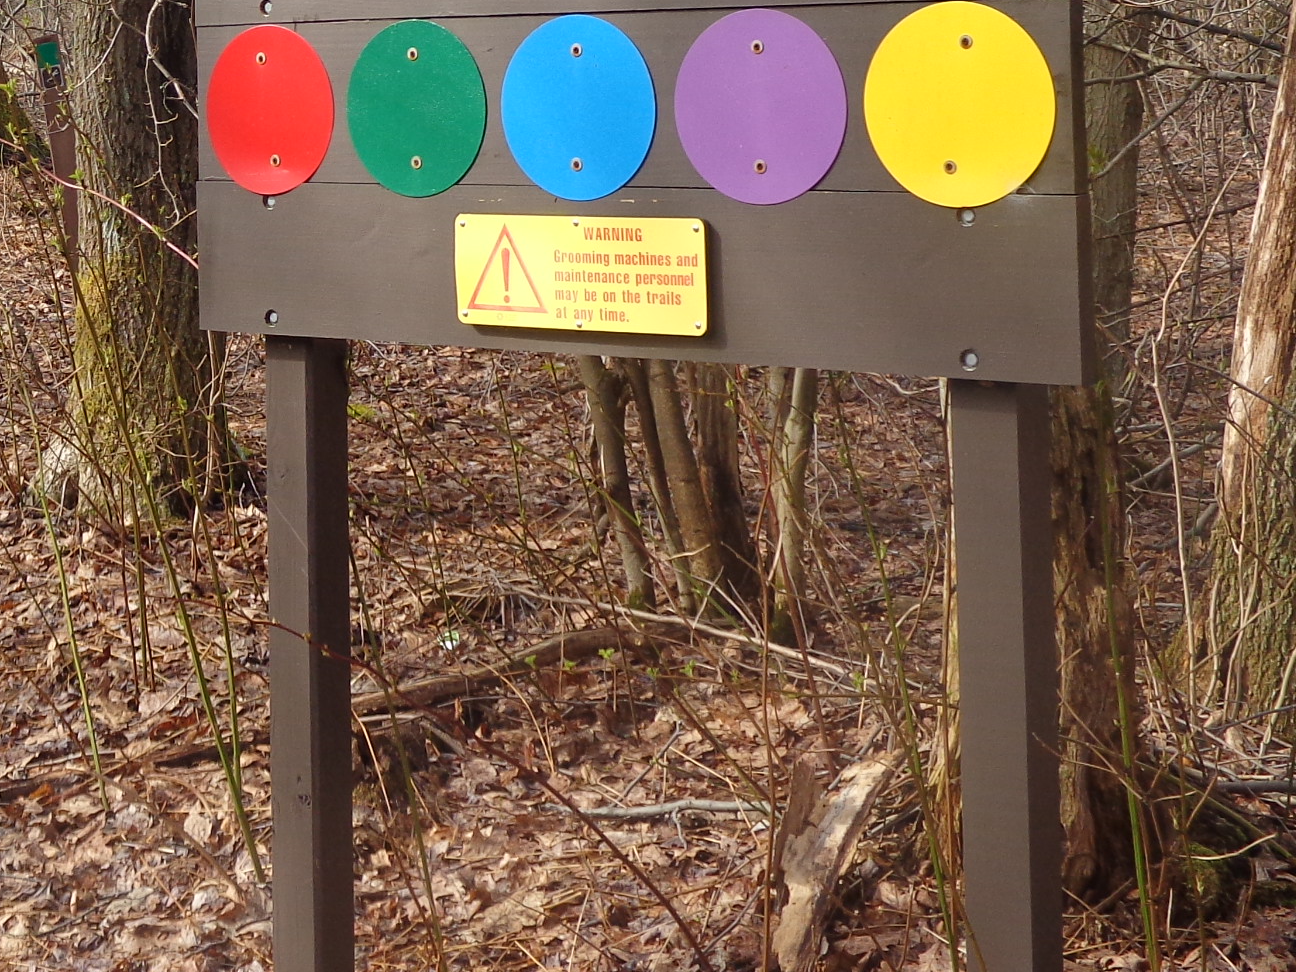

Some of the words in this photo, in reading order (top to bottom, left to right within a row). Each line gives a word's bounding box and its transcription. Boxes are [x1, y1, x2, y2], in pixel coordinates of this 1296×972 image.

[583, 226, 643, 242] WARNING
[554, 249, 610, 267] Grooming
[614, 252, 672, 267] machines
[676, 253, 699, 268] and
[554, 268, 630, 284] maintenance
[635, 272, 695, 288] personnel
[554, 289, 578, 304] may
[584, 288, 597, 302] be
[602, 291, 617, 303] on
[622, 290, 641, 304] the
[646, 290, 682, 306] trails
[555, 307, 568, 319] at
[573, 309, 594, 323] any
[599, 307, 630, 323] time.
